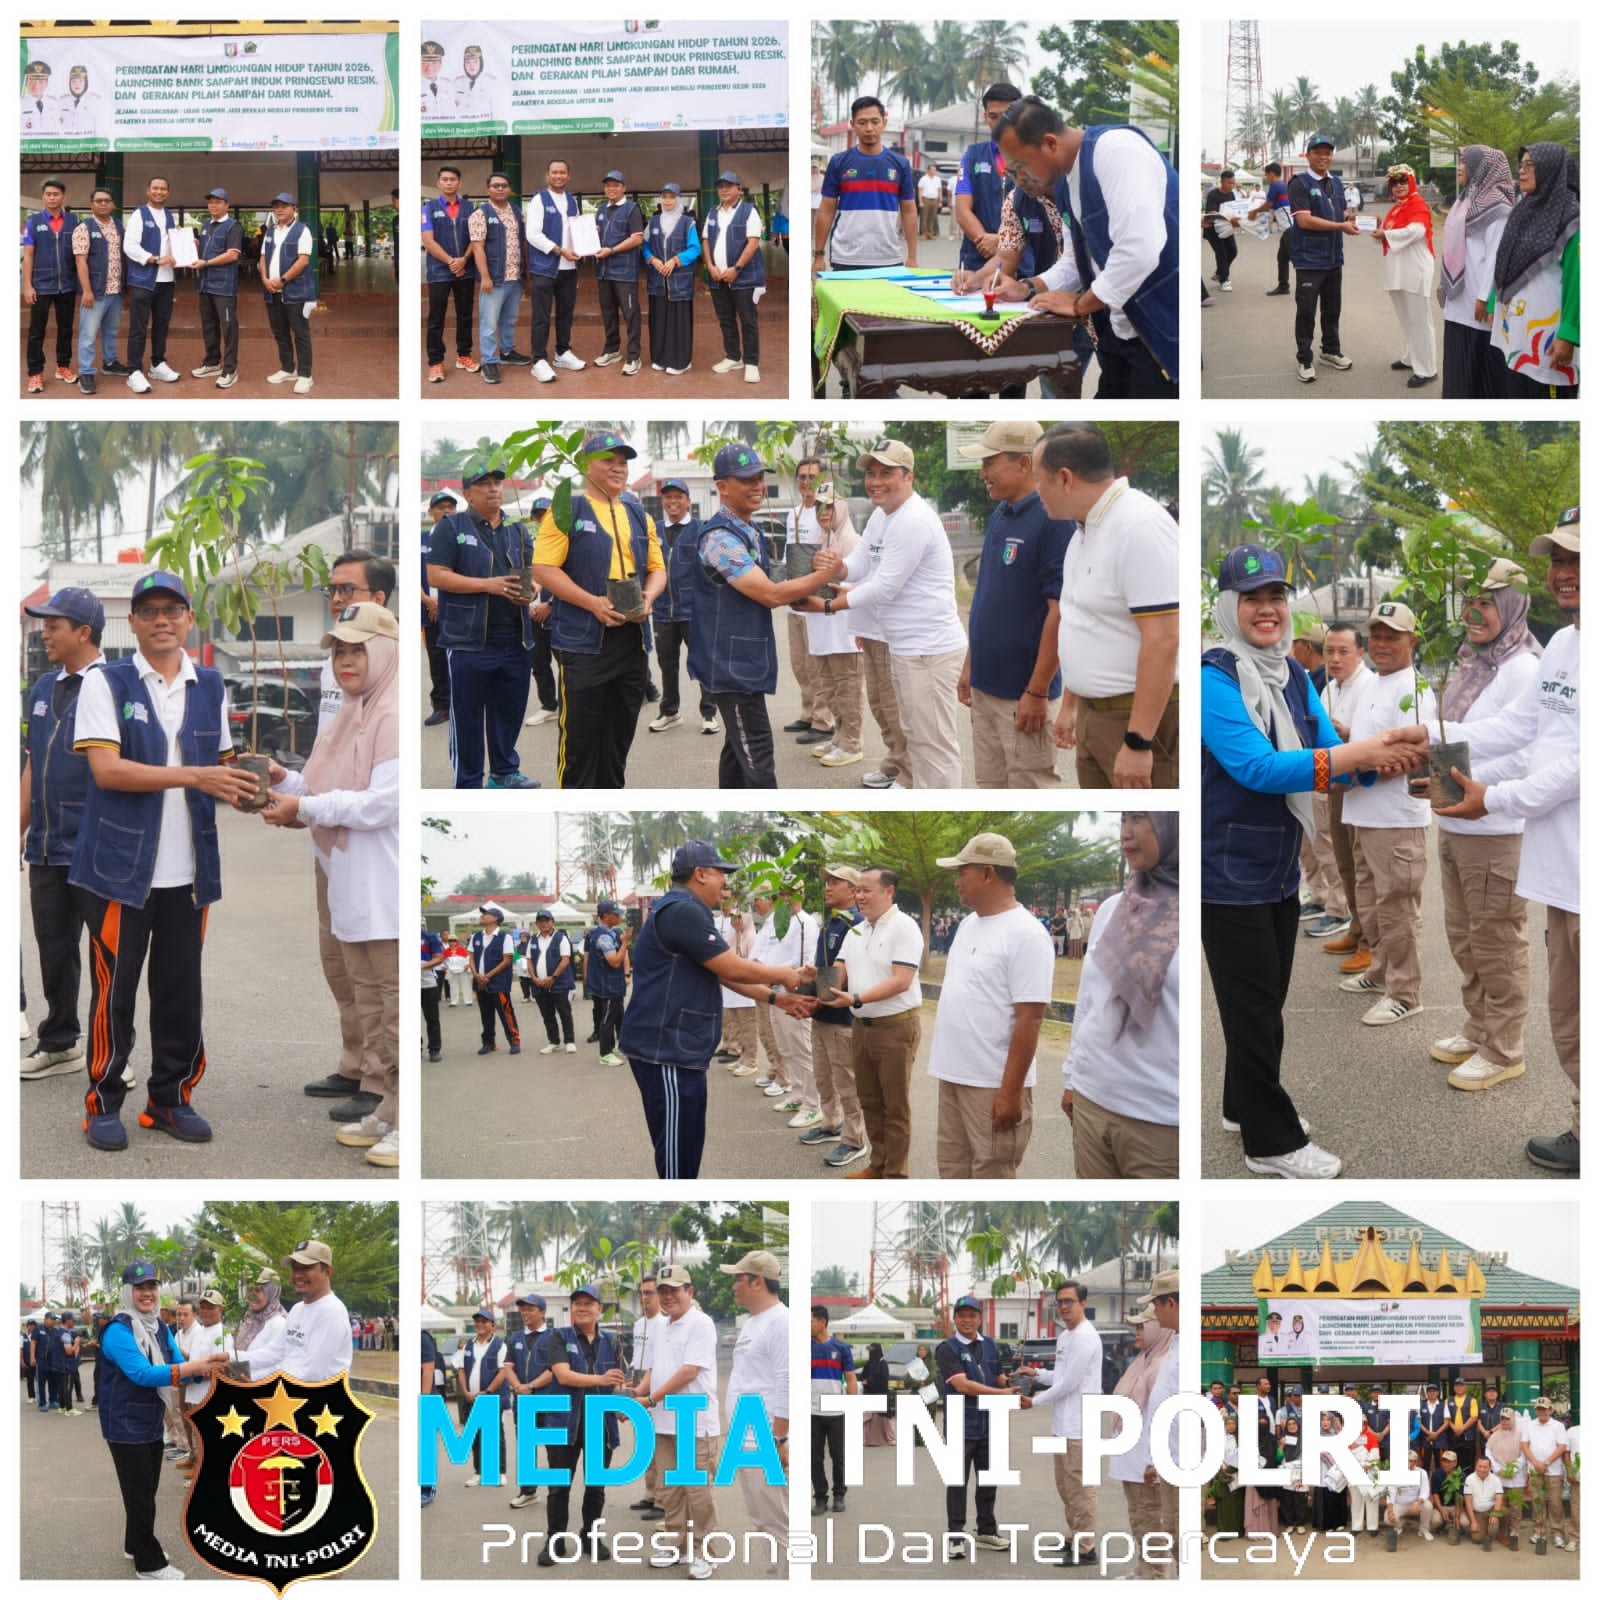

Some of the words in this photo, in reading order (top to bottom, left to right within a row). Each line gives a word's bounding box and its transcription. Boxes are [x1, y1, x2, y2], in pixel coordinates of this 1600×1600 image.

[512, 43, 577, 54] PERINGATAN
[580, 41, 603, 52] HARI
[607, 39, 674, 51] LINGKUNGAN
[678, 38, 710, 48] HIDUP
[712, 37, 748, 47] TAHUN
[512, 57, 572, 67] LAUNCHING
[575, 56, 603, 66] BANK
[606, 54, 649, 65] SAMPAH
[653, 52, 686, 62] INDUK
[689, 51, 751, 61] PRINGSEWU
[115, 65, 178, 75] PERINGATAN
[180, 64, 204, 74] HARI
[207, 63, 272, 73] LINGKUNGAN
[275, 63, 305, 72] HIDUP
[308, 63, 342, 72] TAHUN
[511, 71, 534, 80] DAN
[540, 70, 588, 80] GERAKAN
[591, 69, 621, 79] PILAH
[624, 67, 668, 77] SAMPAH
[671, 66, 695, 76] DARI
[115, 78, 173, 88] LAUNCHING
[176, 78, 203, 87] BANK
[206, 77, 248, 86] SAMPAH
[251, 76, 282, 85] INDUK
[285, 76, 345, 85] PRINGSEWU
[115, 91, 136, 100] DAN
[142, 91, 189, 100] GERAKAN
[192, 90, 220, 99] PILAH
[223, 89, 265, 99] SAMPAH
[268, 89, 291, 98] DARI
